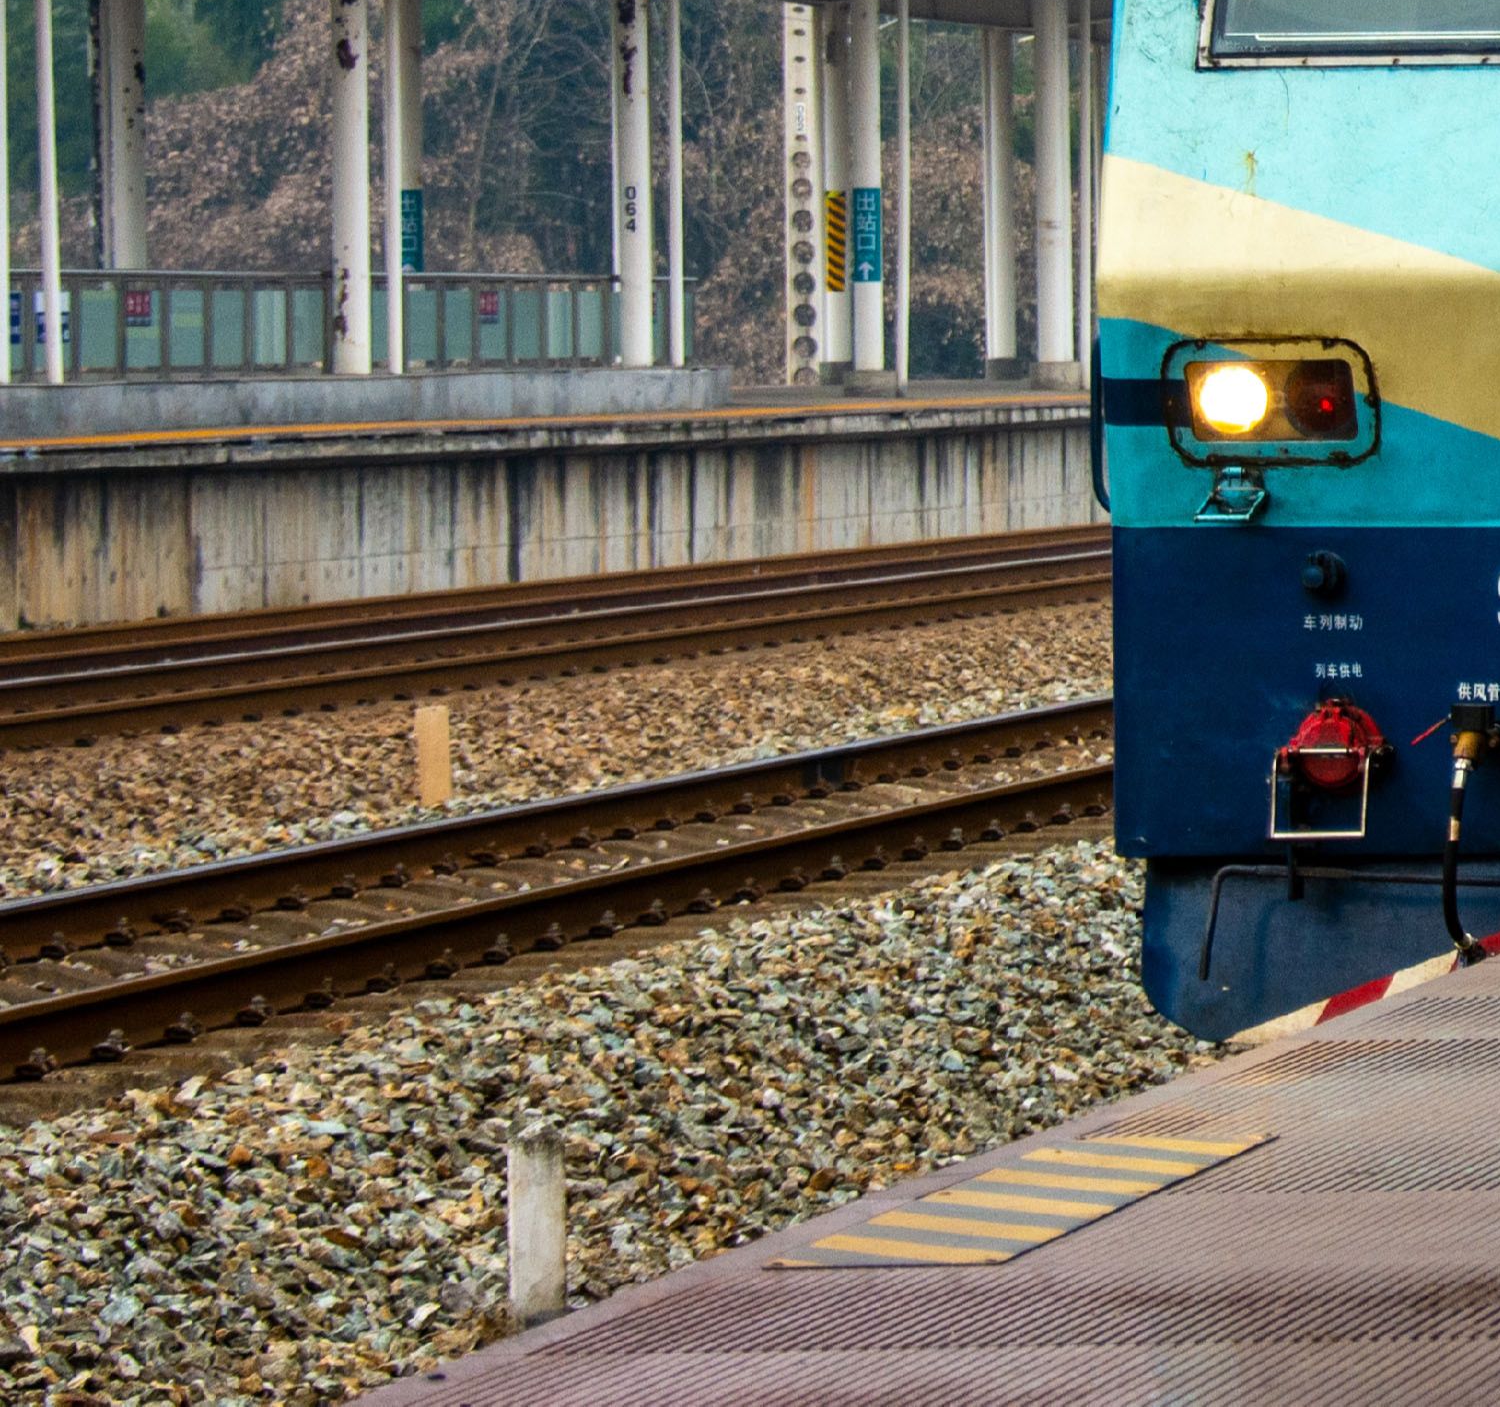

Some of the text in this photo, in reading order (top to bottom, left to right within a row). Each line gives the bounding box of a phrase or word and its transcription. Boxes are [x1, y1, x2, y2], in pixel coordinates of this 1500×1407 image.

[625, 185, 637, 233] 064
[857, 192, 877, 251] 出站口
[1303, 613, 1363, 632] 车列制动
[1315, 661, 1363, 679] 列车供电
